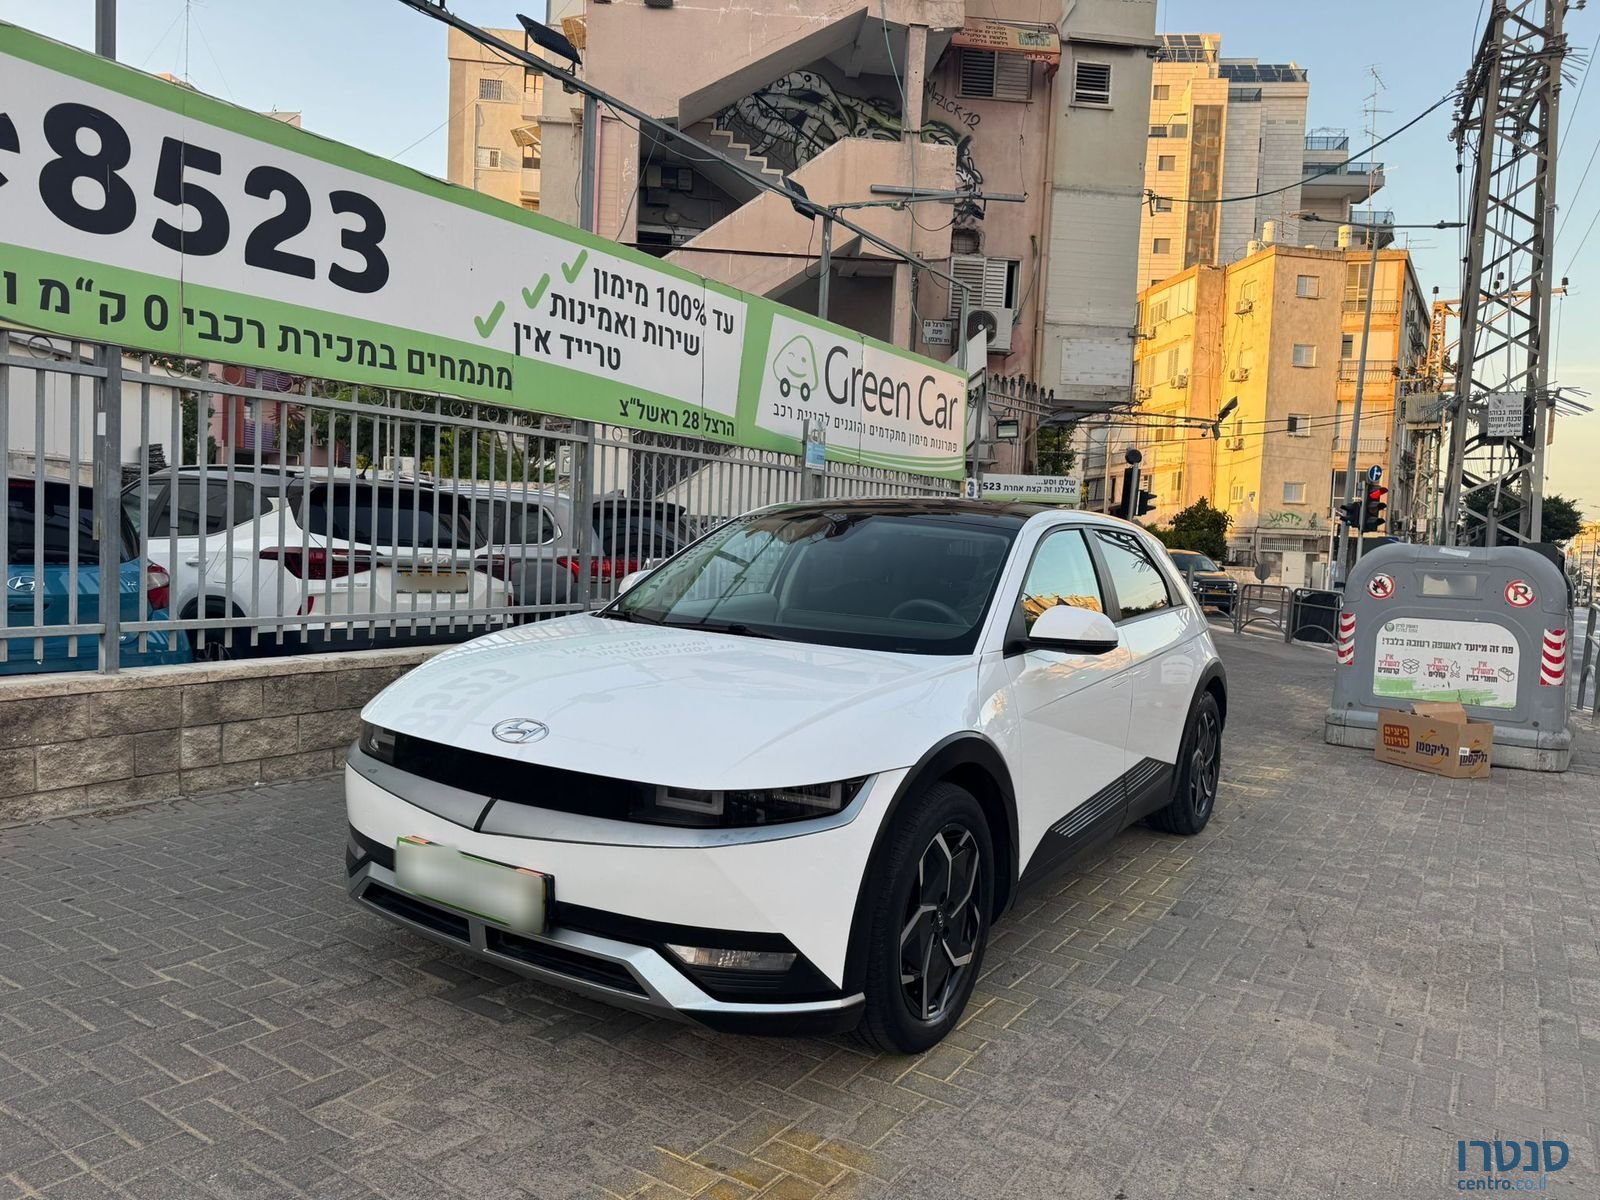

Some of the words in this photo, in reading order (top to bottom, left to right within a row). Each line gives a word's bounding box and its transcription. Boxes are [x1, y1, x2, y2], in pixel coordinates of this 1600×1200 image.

[0, 102, 390, 294] 8523
[593, 267, 648, 307] מימון
[144, 294, 169, 332] 0
[656, 287, 707, 326] 100%
[550, 292, 636, 340] ואמינות
[713, 309, 734, 334] עד
[182, 307, 266, 349] רכבי
[513, 322, 551, 356] אין
[642, 320, 700, 356] שירות
[277, 324, 397, 371] במכירת
[560, 333, 621, 370] טרייד
[407, 348, 513, 391] מתמחים
[825, 345, 911, 421] Green
[918, 375, 958, 431] Car
[682, 410, 699, 430] 28
[773, 403, 793, 419] רכב
[703, 412, 735, 437] הרצל
[834, 416, 866, 435] והוגנים
[869, 424, 906, 442] מתקדמים
[909, 432, 928, 447] מימון
[930, 438, 958, 453] פתרונות
[1003, 484, 1024, 492] אחרת
[1026, 485, 1042, 494] קצת
[1043, 485, 1052, 493] זה
[1054, 485, 1076, 494] אצלנו
[1381, 637, 1405, 646] בלבד!
[1406, 639, 1430, 648] רטובה
[1431, 641, 1462, 650] לאשפה
[1464, 643, 1488, 652] מיועד
[1489, 645, 1500, 653] זה
[1502, 646, 1514, 654] פח
[1384, 725, 1409, 737] ביצים
[1384, 736, 1409, 746] טריות
[1415, 740, 1450, 757] גליקסמן
